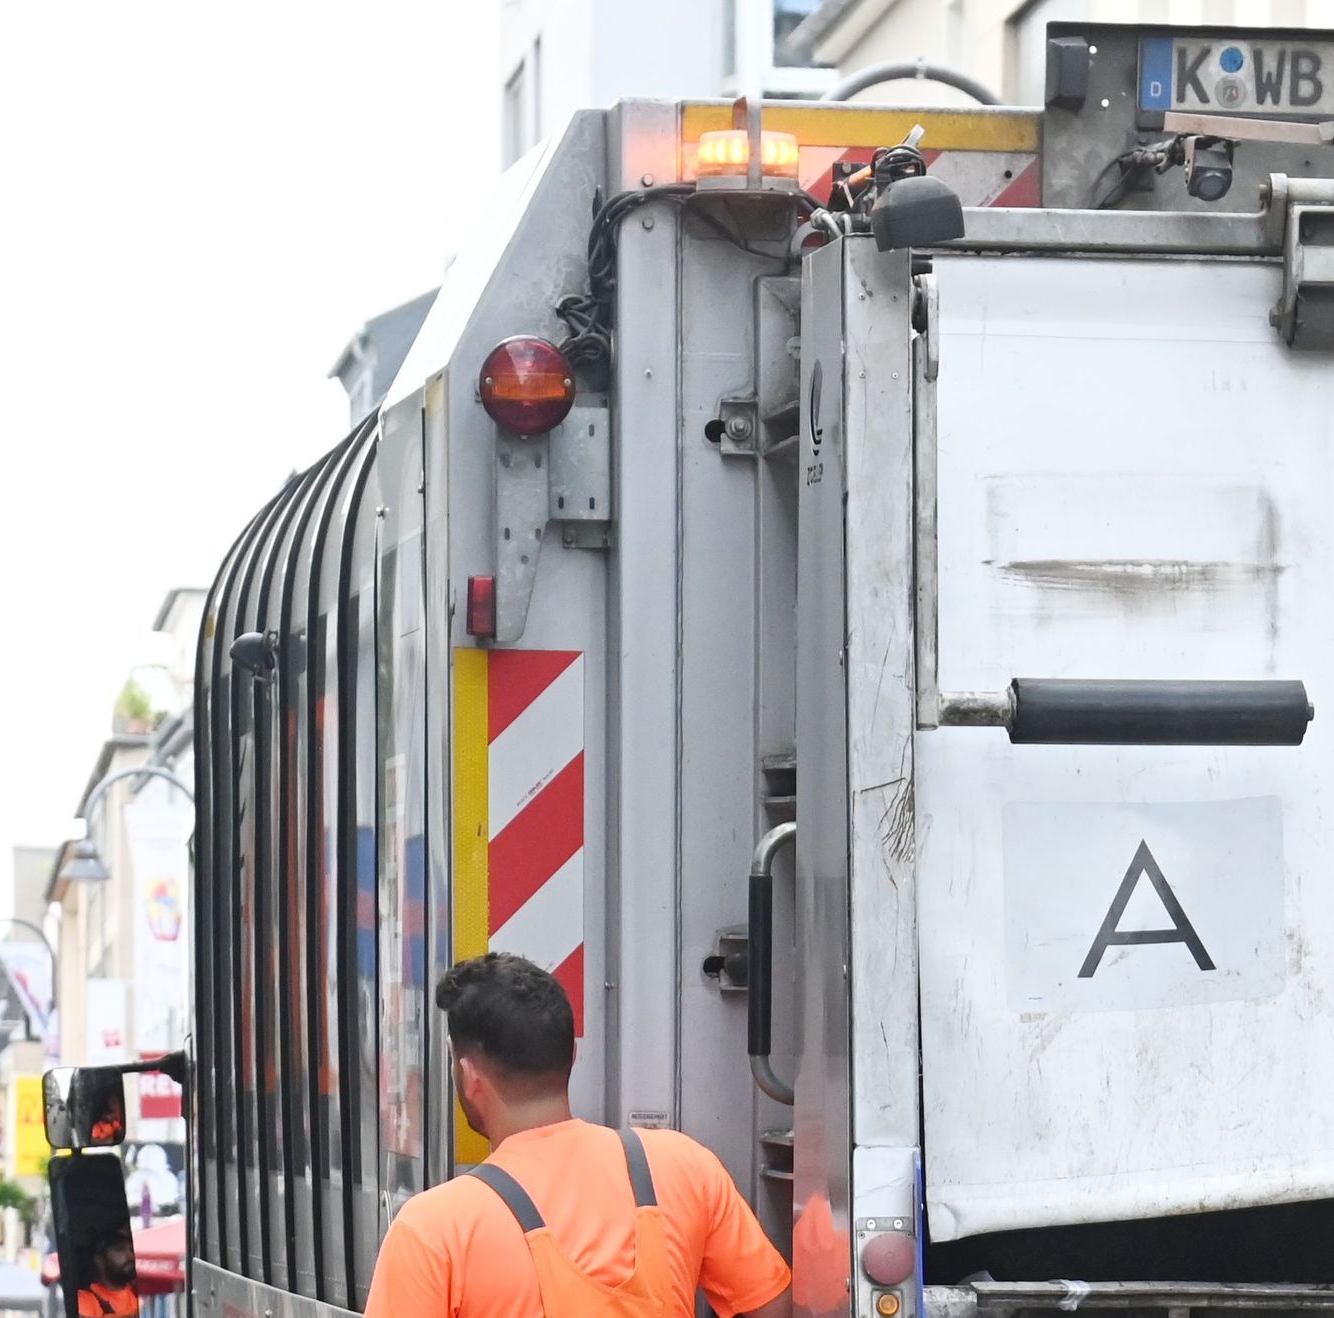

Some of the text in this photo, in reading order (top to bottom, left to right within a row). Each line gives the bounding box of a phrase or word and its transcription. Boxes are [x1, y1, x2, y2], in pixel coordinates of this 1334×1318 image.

[1150, 81, 1162, 97] D
[1175, 46, 1212, 105] K
[1253, 48, 1324, 108] WB
[1077, 839, 1217, 978] A
